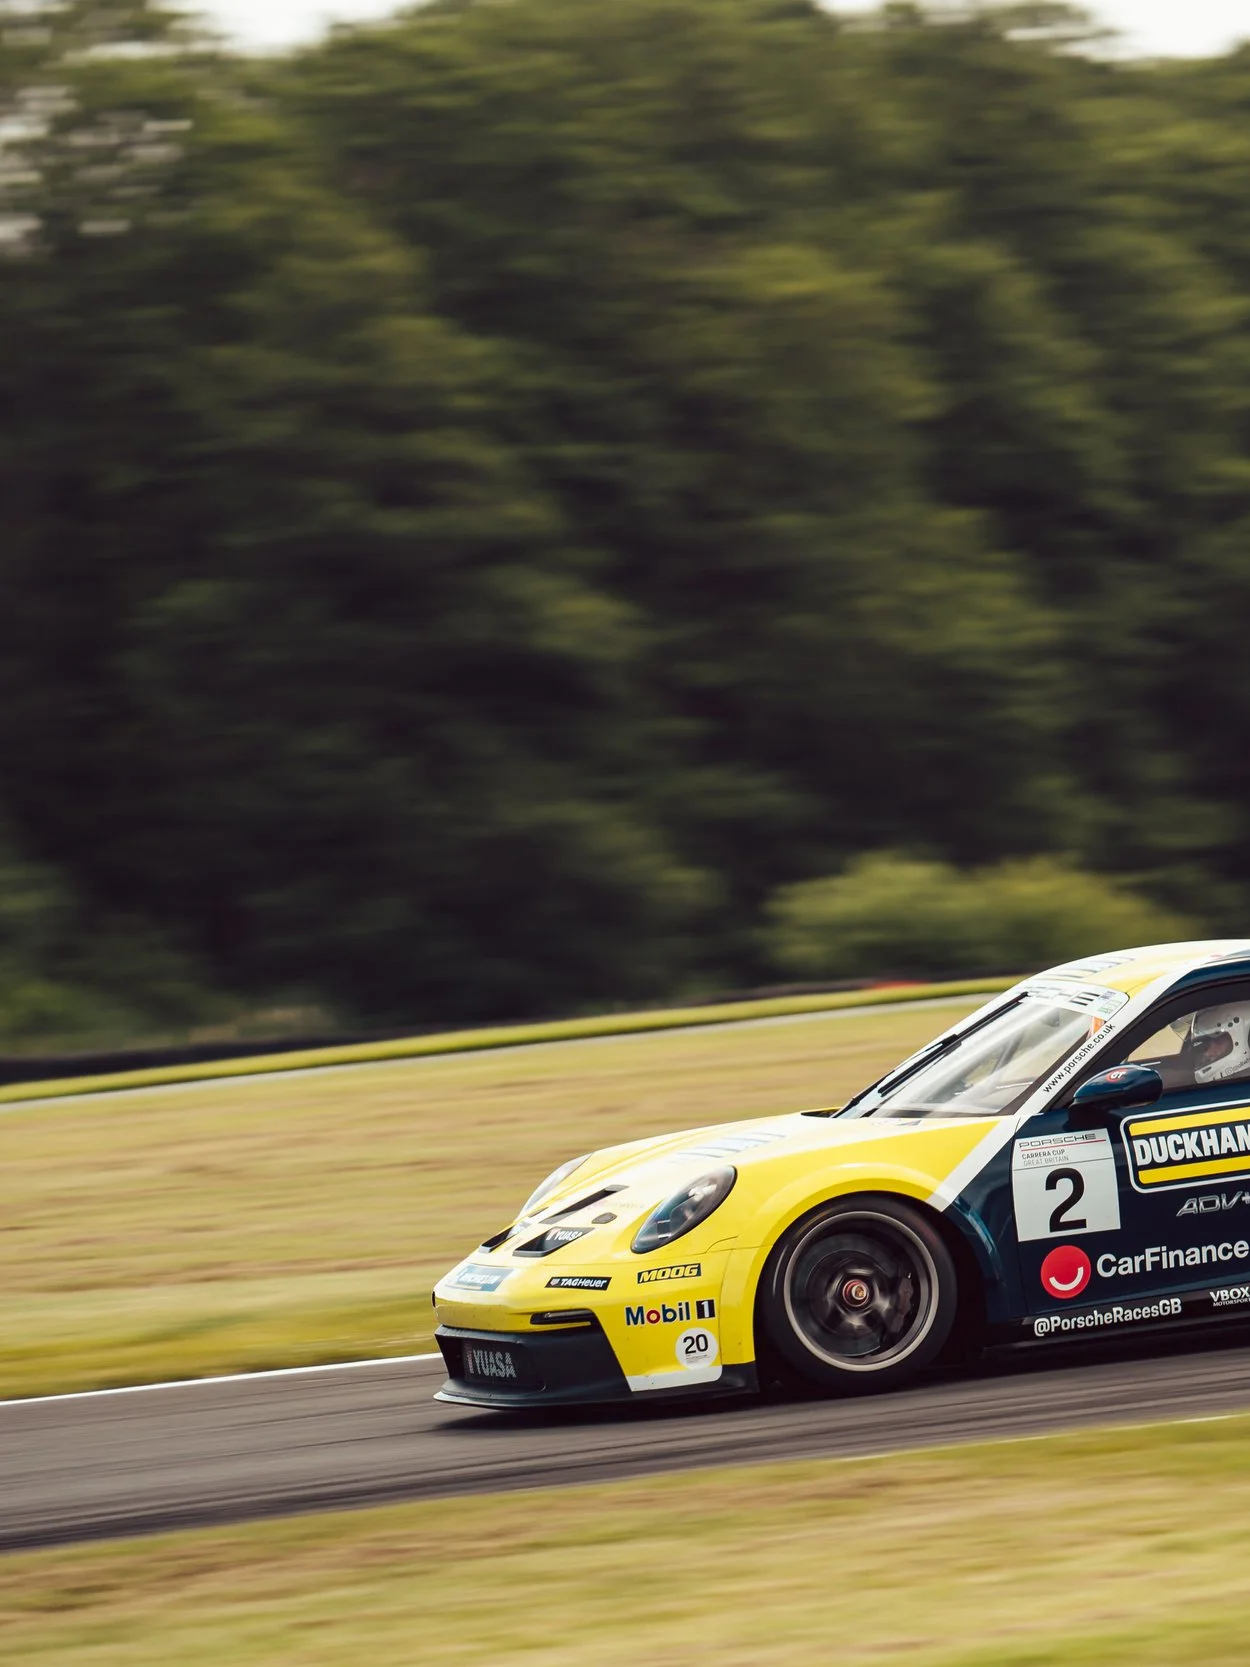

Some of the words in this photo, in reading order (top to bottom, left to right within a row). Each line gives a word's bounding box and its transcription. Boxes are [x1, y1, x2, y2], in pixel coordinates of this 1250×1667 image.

[1043, 1024, 1115, 1093] www.porsche.co.uk
[1018, 1133, 1097, 1147] PORSCHE
[1021, 1150, 1051, 1160] CARRERA
[1052, 1148, 1066, 1157] CUP
[1023, 1158, 1043, 1167] GREAT
[1044, 1155, 1069, 1164] BRITAIN
[1045, 1167, 1087, 1233] 2
[1096, 1240, 1250, 1278] CarFinance
[639, 1264, 699, 1283] MOOG
[1210, 1286, 1250, 1302] VBOX
[625, 1301, 690, 1326] Mobil
[1033, 1298, 1183, 1337] @PorscheRacesGB
[683, 1334, 709, 1355] 20
[472, 1348, 517, 1378] YUASA
